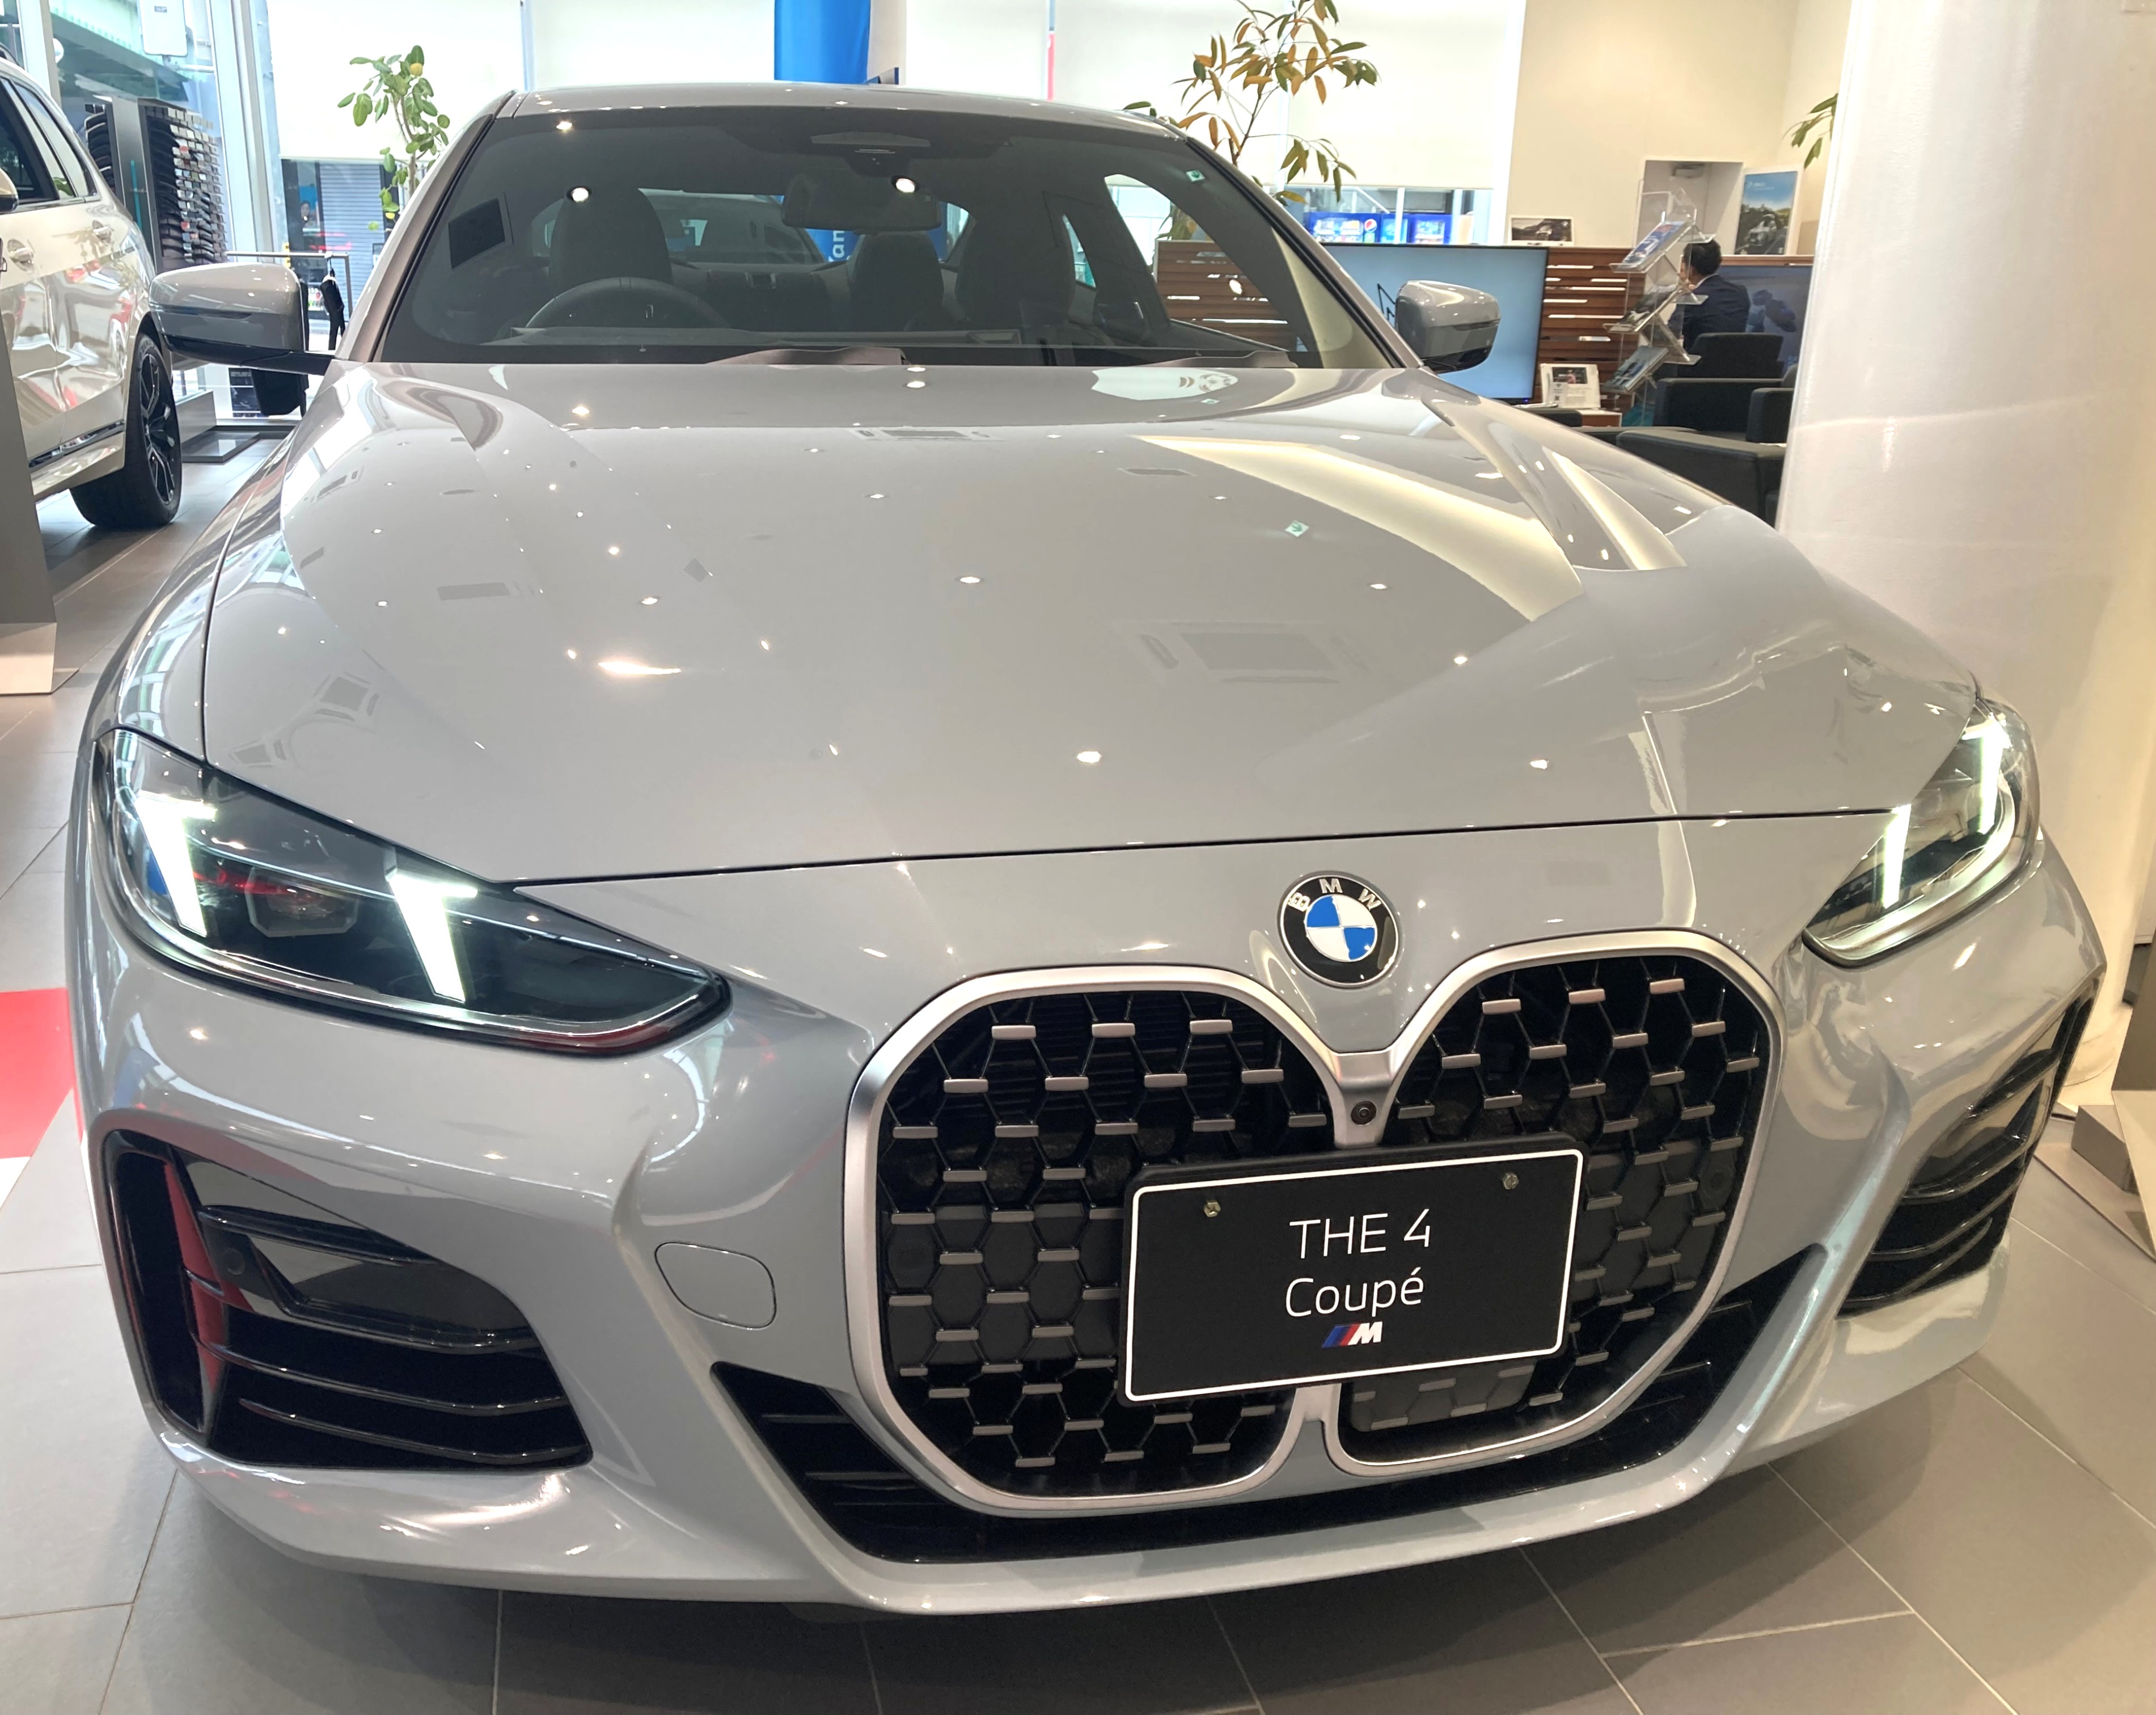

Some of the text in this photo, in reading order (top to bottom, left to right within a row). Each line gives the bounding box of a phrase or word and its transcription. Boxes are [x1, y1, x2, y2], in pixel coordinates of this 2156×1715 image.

[1287, 878, 1381, 912] BMW
[1289, 1209, 1430, 1259] THE 4
[1286, 1267, 1424, 1317] Coupé
